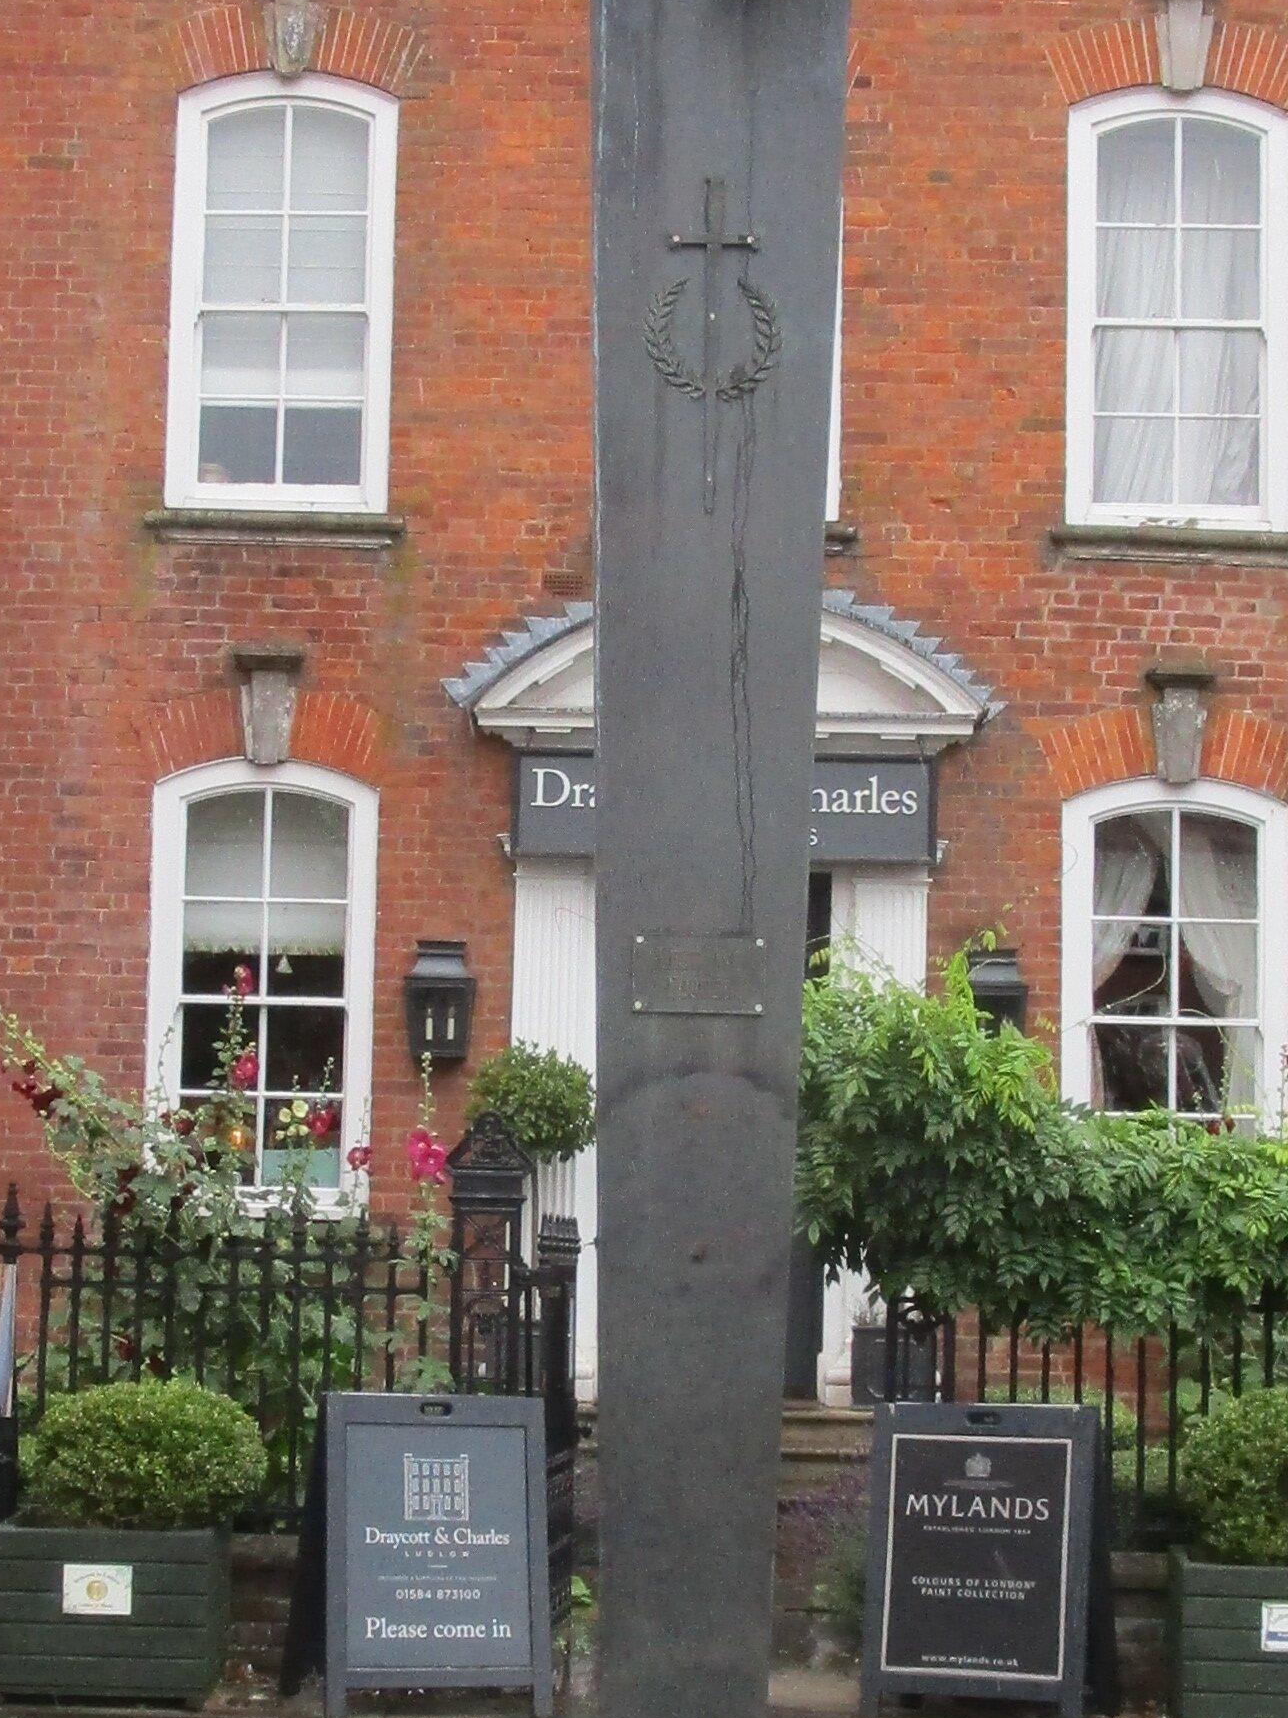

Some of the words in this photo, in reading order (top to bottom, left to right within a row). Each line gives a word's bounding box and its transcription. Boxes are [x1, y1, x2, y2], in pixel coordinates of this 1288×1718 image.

[905, 1493, 1050, 1520] MYLANDS
[365, 1526, 431, 1549] Draycott
[434, 1527, 451, 1544] &
[453, 1528, 510, 1545] Charles
[912, 1575, 961, 1586] COLOURS
[966, 1578, 981, 1587] OF
[395, 1588, 432, 1600] 01584
[921, 1587, 952, 1596] PAINT
[957, 1589, 1026, 1600] COLLECTION
[365, 1616, 427, 1639] Please
[434, 1623, 486, 1638] come
[492, 1618, 512, 1638] in
